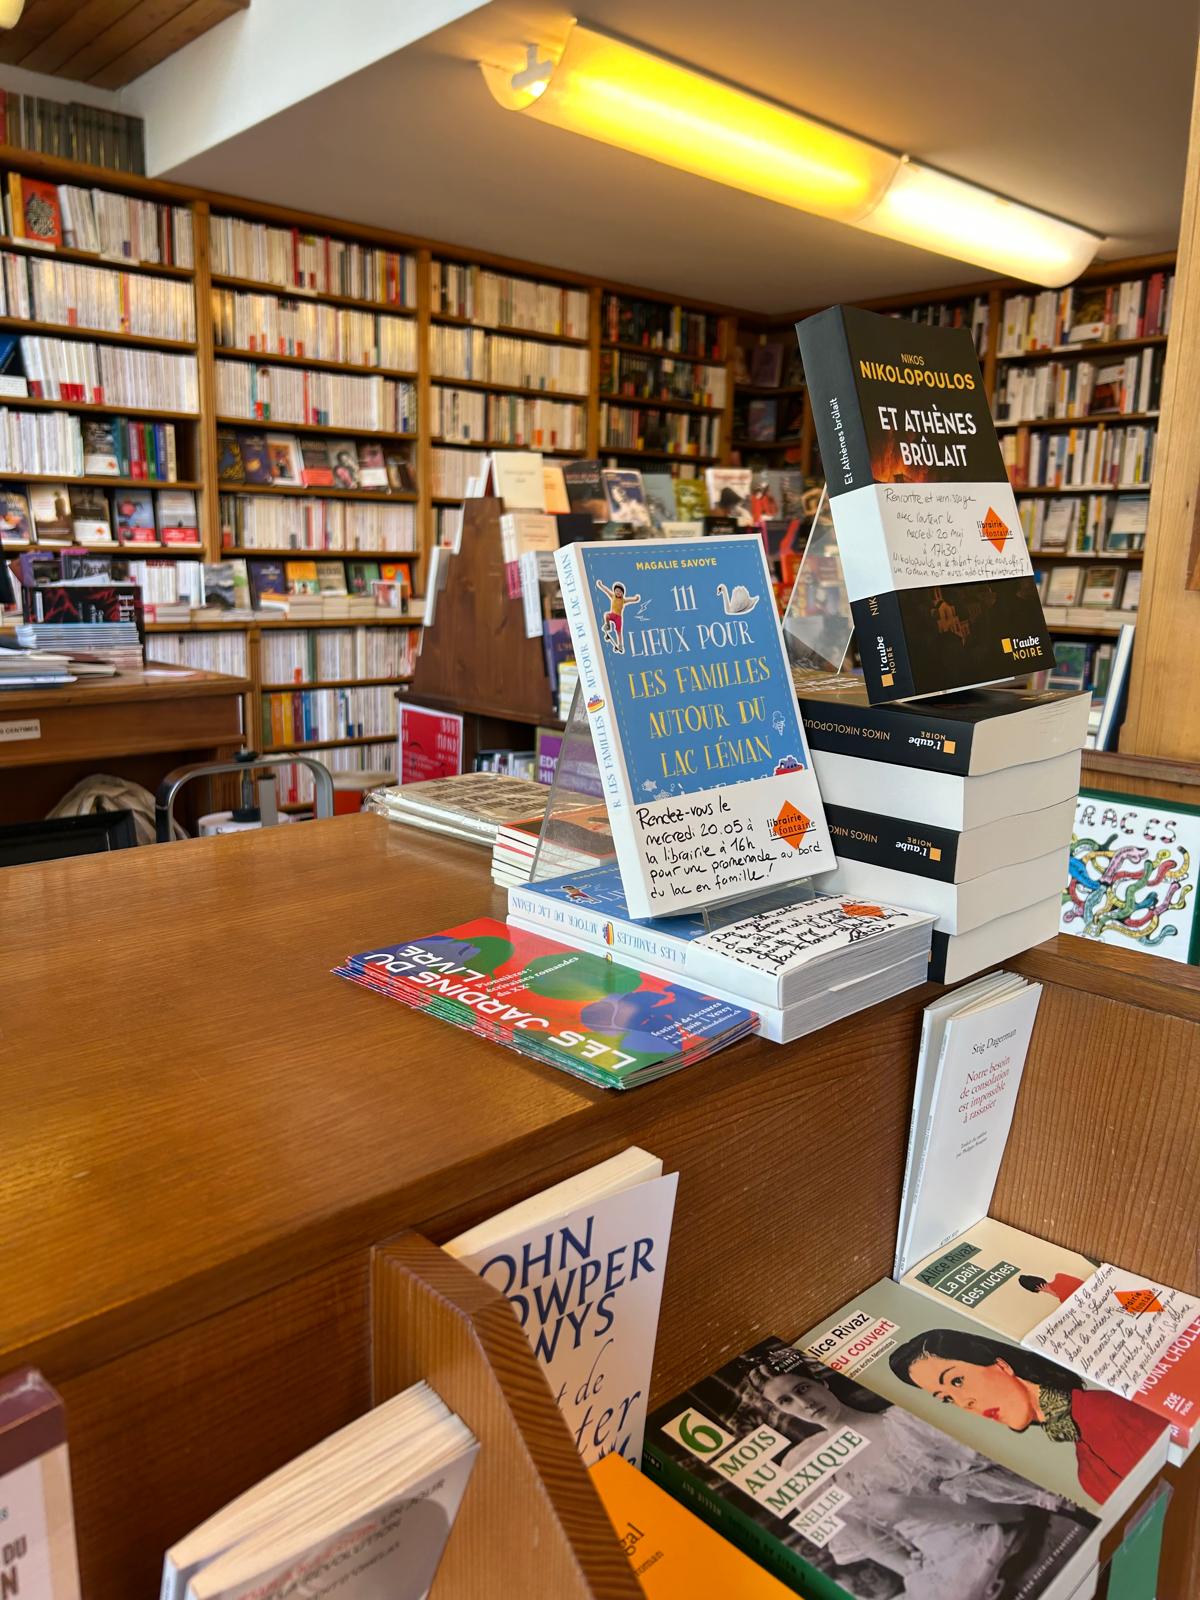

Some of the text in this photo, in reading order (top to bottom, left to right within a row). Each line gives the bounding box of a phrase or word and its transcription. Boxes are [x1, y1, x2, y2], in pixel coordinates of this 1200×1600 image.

[859, 360, 975, 390] NIKOLOPOULOS
[901, 353, 925, 366] NIKOS
[878, 403, 977, 435] ET ATHÈNES
[829, 397, 854, 485] Et Athènes brûlait
[899, 435, 968, 467] BRÛLAIT
[883, 488, 923, 505] Rencontre
[924, 493, 934, 504] et
[937, 529, 948, 540] 20
[976, 520, 1003, 529] librairie
[636, 557, 717, 571] MAGALIE SAVOYE
[671, 584, 699, 612] 111
[868, 597, 879, 616] NIK
[628, 620, 755, 657] LIEUX POUR
[876, 635, 890, 672] l'aube
[1012, 636, 1040, 649] l'aube
[1012, 645, 1043, 661] NOIRE
[580, 643, 597, 690] AUTOUR
[886, 646, 897, 675] NOIRE
[628, 656, 771, 699] LES FAMILLES
[649, 696, 767, 739] AUTOUR DU
[804, 718, 891, 741] NIKOS NIKOLOPOUL
[594, 716, 614, 769] FAMILLES
[908, 736, 941, 750] l'aube
[920, 730, 946, 741] NOIRE
[661, 735, 773, 778] LAC LÉMAN
[607, 774, 620, 794] LES
[636, 795, 731, 830] Rendez-vous le
[766, 813, 802, 828] librairie
[1077, 804, 1177, 843] RACES
[646, 818, 754, 846] mercredi 20.05 à
[768, 828, 778, 837] la
[779, 820, 816, 834] fontaine
[850, 827, 878, 843] NIKOS
[907, 836, 932, 848] NOIRE
[646, 837, 756, 864] la librairie à 16h
[650, 842, 823, 884] pour une promenade au bord
[895, 841, 927, 857] l'aube
[650, 885, 665, 899] du
[672, 883, 692, 896] lac
[696, 882, 711, 892] en
[617, 931, 658, 956] FAMILLES
[399, 945, 486, 984] LIVRE
[535, 956, 579, 977] romandes
[364, 953, 637, 1070] LES JARDINS DU
[651, 1002, 722, 1037] festival de lectures
[706, 1006, 733, 1018] Vevey
[972, 1028, 1017, 1055] Stig Dagerman
[960, 1069, 1010, 1100] de consolation
[966, 1056, 1011, 1085] Notre besoin
[970, 1081, 1006, 1107] impossible
[478, 1215, 595, 1295] OHN
[921, 1262, 949, 1284] Alice
[947, 1244, 977, 1264] Rivaz
[508, 1237, 656, 1329] OWPER
[938, 1264, 980, 1295] La paix
[961, 1263, 1015, 1305] des ruches
[533, 1291, 616, 1365] WYS
[808, 1313, 870, 1358] lice Rivaz
[830, 1320, 895, 1371] eu couvert
[1139, 1314, 1200, 1395] MONA CHOLLE
[575, 1338, 614, 1406] de
[678, 1413, 724, 1453] 6
[718, 1431, 777, 1477] MOIS
[744, 1464, 777, 1495] AU
[765, 1431, 864, 1513] MEXIQUE
[795, 1490, 845, 1533] NELLIE
[810, 1518, 840, 1544] BLY
